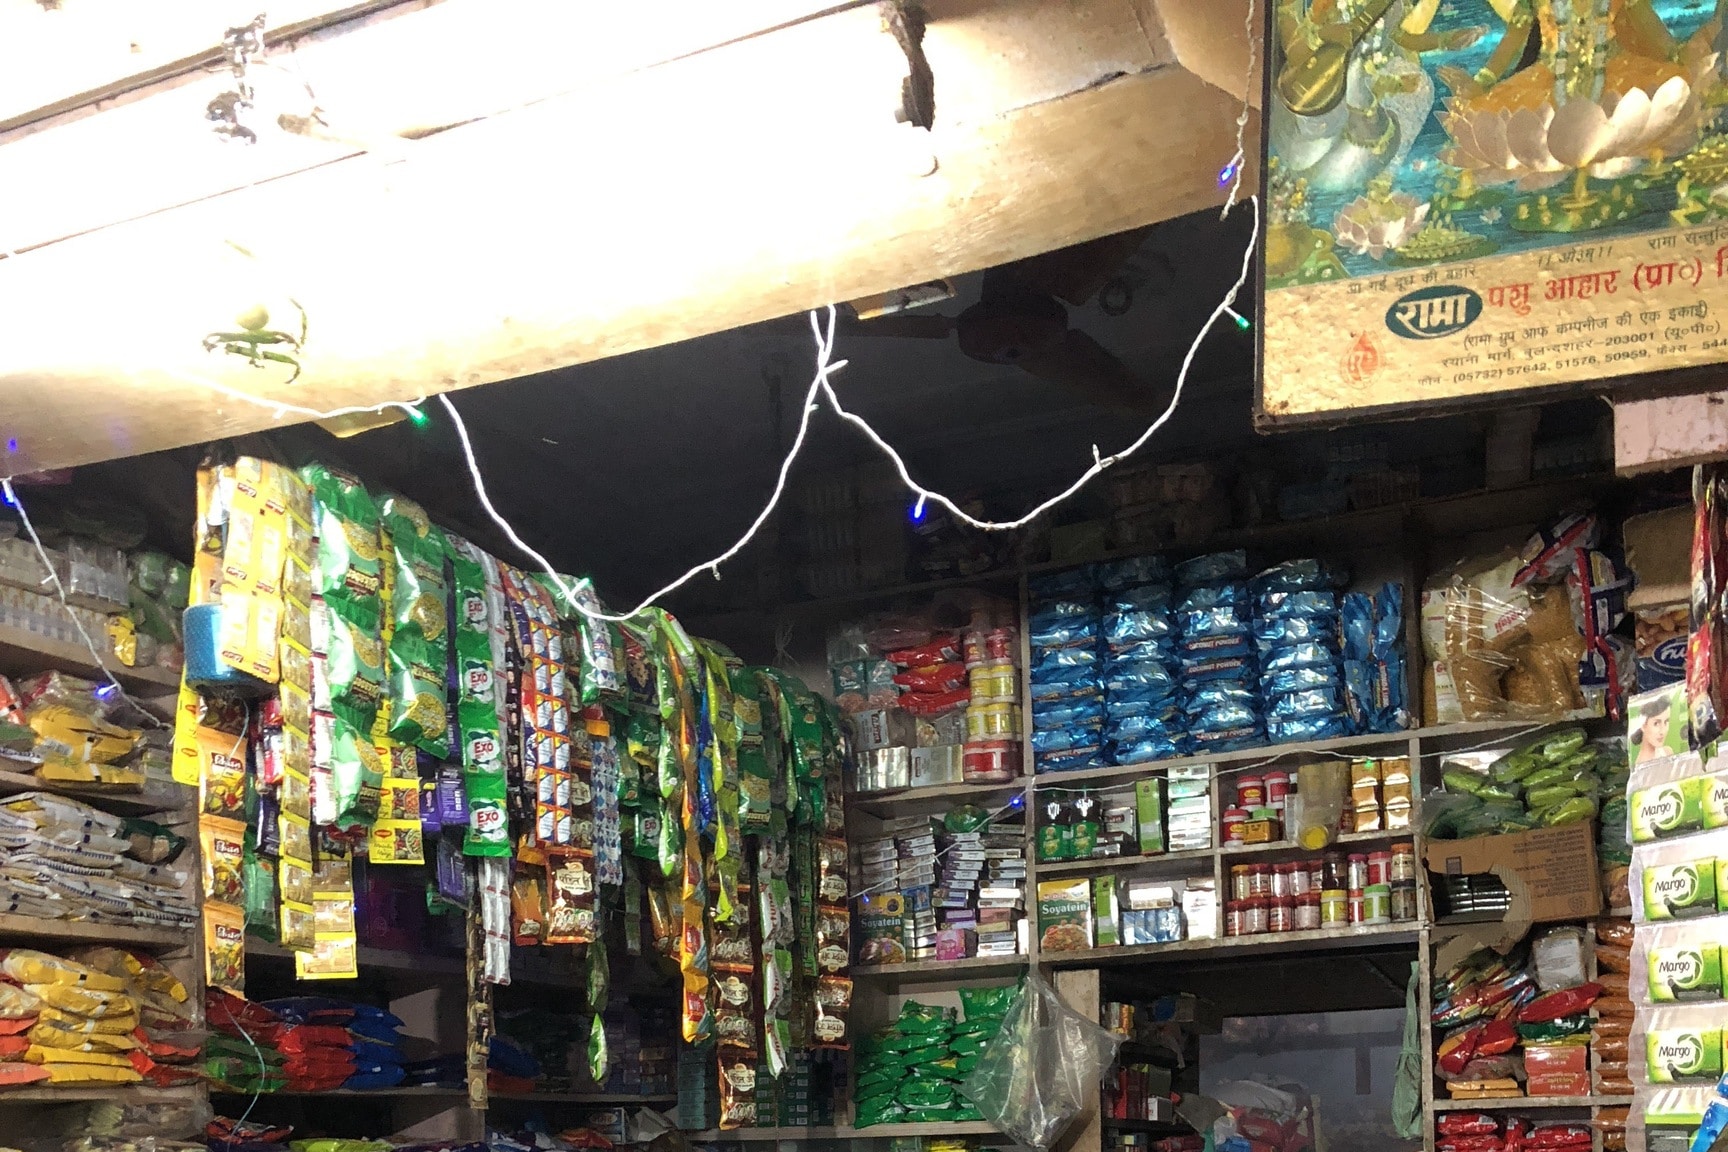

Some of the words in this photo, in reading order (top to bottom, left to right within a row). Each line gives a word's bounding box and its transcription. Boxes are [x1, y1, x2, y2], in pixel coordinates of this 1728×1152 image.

[1648, 235, 1676, 249] रामा
[1368, 277, 1388, 292] गई
[1394, 275, 1415, 290] दूध
[1421, 271, 1439, 283] की
[1488, 282, 1534, 316] पशु
[1544, 269, 1621, 301] आहार
[1395, 294, 1471, 337] रामा
[1464, 333, 1491, 350] (रामा
[1556, 317, 1609, 335] कम्पनीज
[1616, 311, 1632, 326] की
[1639, 310, 1661, 325] एक
[1640, 802, 1671, 818] Margo
[1655, 878, 1686, 893] Margo
[1041, 903, 1087, 916] Soyatein
[860, 917, 901, 929] Soyatein
[1658, 960, 1690, 975] Margo
[1658, 1044, 1691, 1058] Margo
